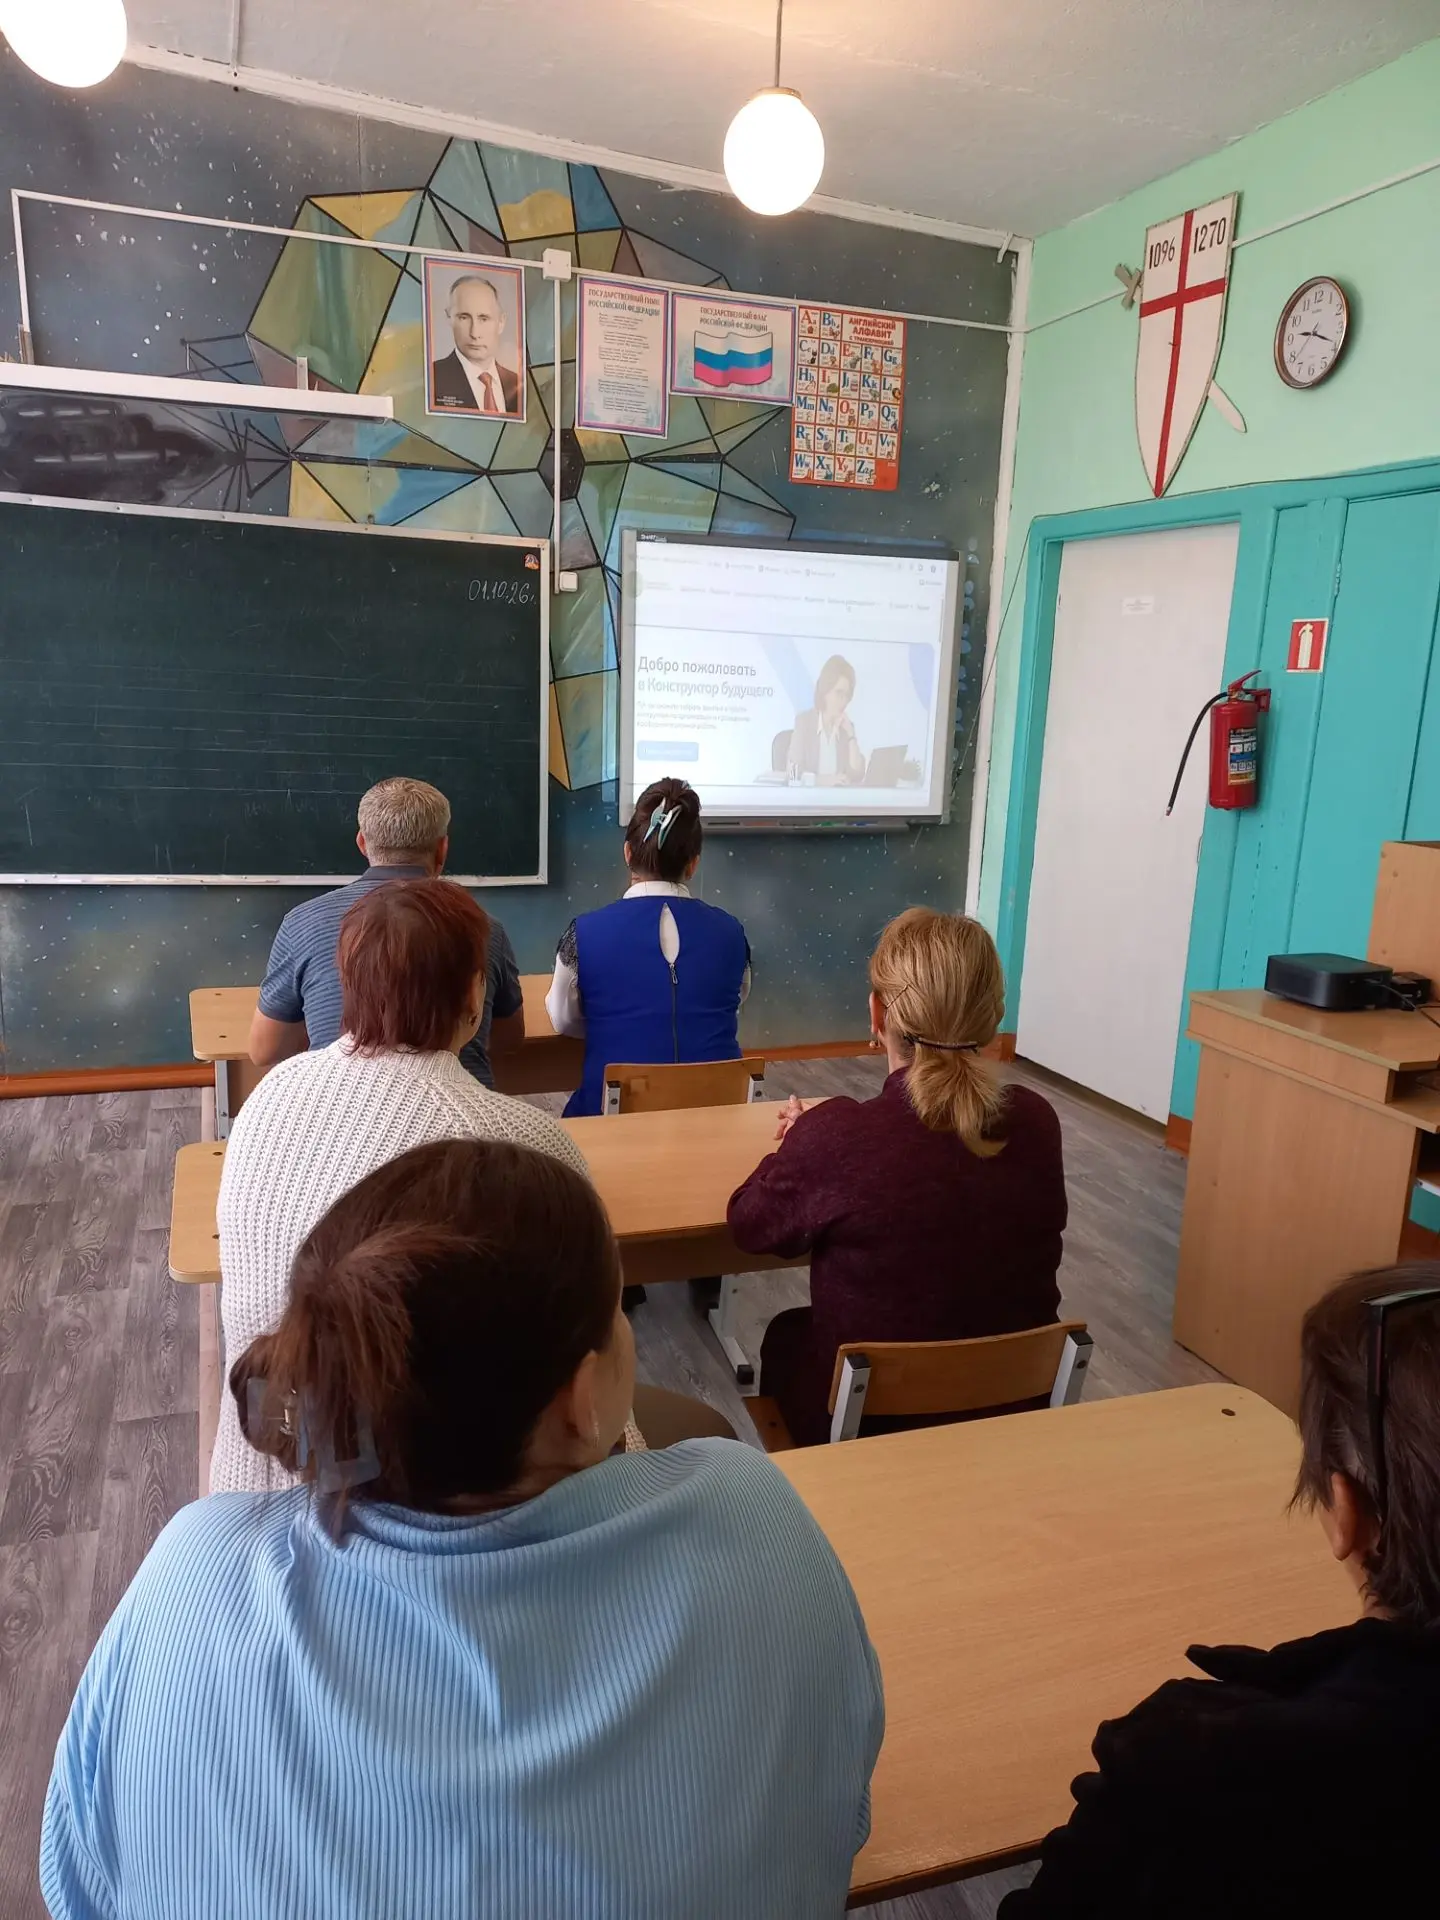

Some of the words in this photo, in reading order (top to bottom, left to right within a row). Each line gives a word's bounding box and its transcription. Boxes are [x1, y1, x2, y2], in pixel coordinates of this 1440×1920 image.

[1148, 237, 1176, 270] 1096
[1193, 216, 1227, 254] 1270
[1314, 290, 1324, 304] 12
[1302, 299, 1310, 312] 11
[1335, 304, 1343, 316] 2
[849, 317, 896, 331] АНГЛИЙСКИЙ
[1291, 315, 1302, 328] 10
[852, 327, 892, 339] АЛФАВИТ
[1287, 333, 1294, 346] 9
[1289, 351, 1296, 364] 8
[1320, 356, 1328, 369] 5
[1298, 362, 1304, 375] 7
[1308, 365, 1315, 376] 6
[637, 656, 679, 675] Добро
[682, 661, 757, 677] пожаловать
[638, 682, 645, 691] в
[647, 677, 719, 697] Конструктор
[721, 681, 774, 699] будущего
